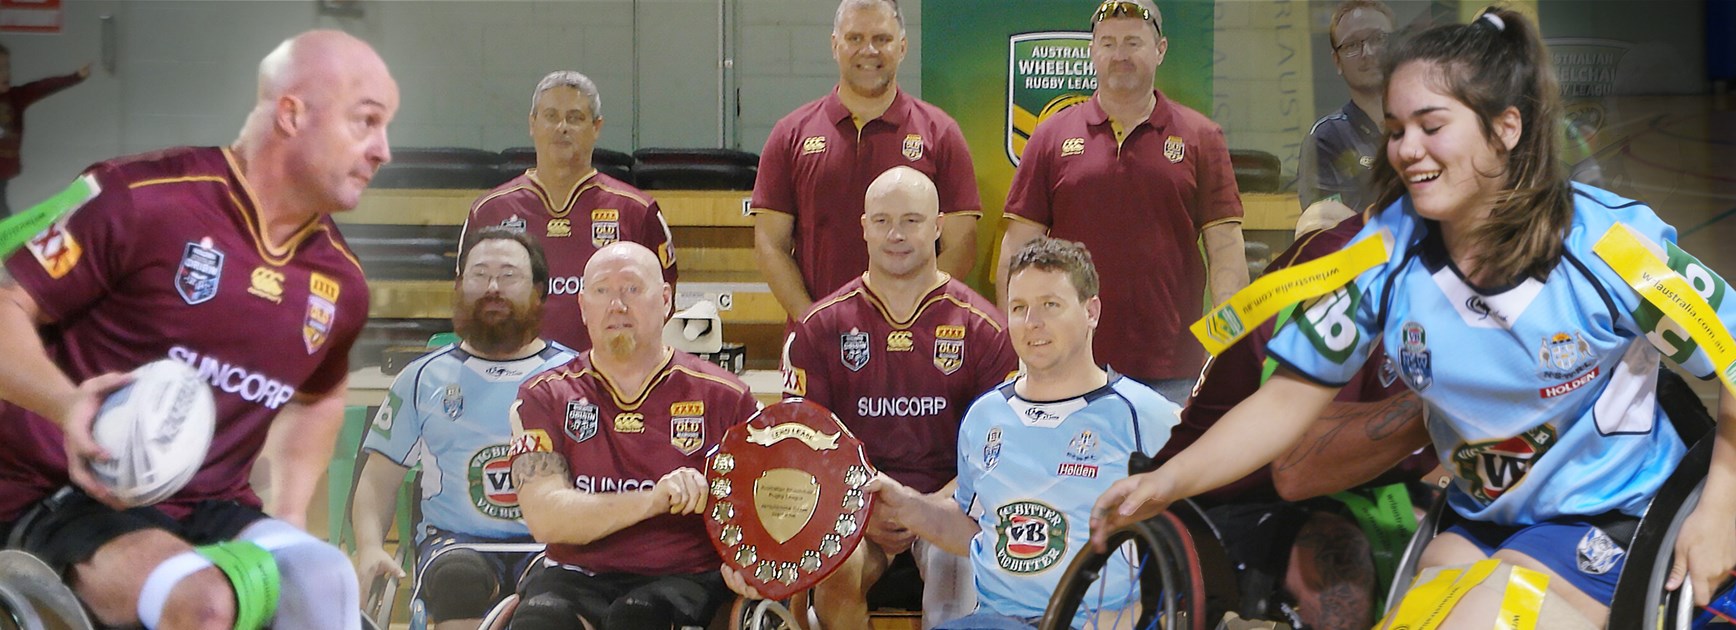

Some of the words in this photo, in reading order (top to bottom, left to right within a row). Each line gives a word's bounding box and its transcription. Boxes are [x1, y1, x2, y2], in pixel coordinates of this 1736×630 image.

[1019, 60, 1097, 76] WHEELCH
[1025, 77, 1065, 90] RUGBY
[719, 293, 731, 307] C
[1545, 370, 1596, 398] HOLDEN
[857, 396, 947, 417] SUNCORP
[1060, 463, 1096, 478] Holden
[1014, 503, 1062, 527] BITTER
[1010, 521, 1047, 542] VB
